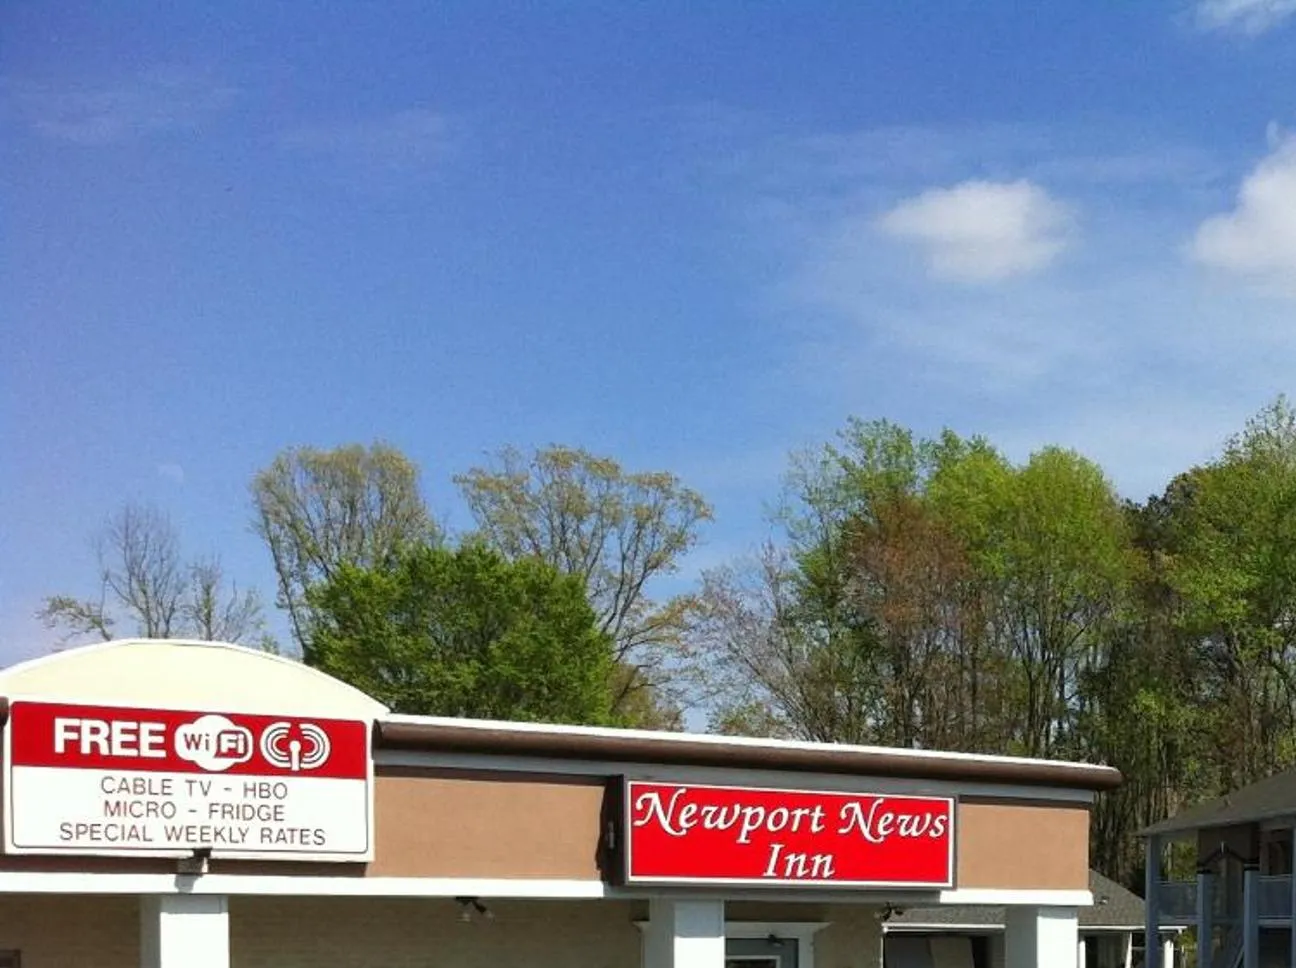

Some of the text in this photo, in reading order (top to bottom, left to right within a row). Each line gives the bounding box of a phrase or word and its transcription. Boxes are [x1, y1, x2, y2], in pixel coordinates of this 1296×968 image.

[55, 718, 167, 758] FREE
[100, 776, 172, 797] CABLE
[185, 779, 213, 798] TV
[243, 782, 288, 800] HBO
[103, 800, 177, 820] MICRO
[208, 803, 285, 823] FRIDGE
[633, 788, 948, 844] Newport News
[59, 822, 326, 846] SPECIAL WEEKLY RATES
[763, 844, 835, 879] Inn
